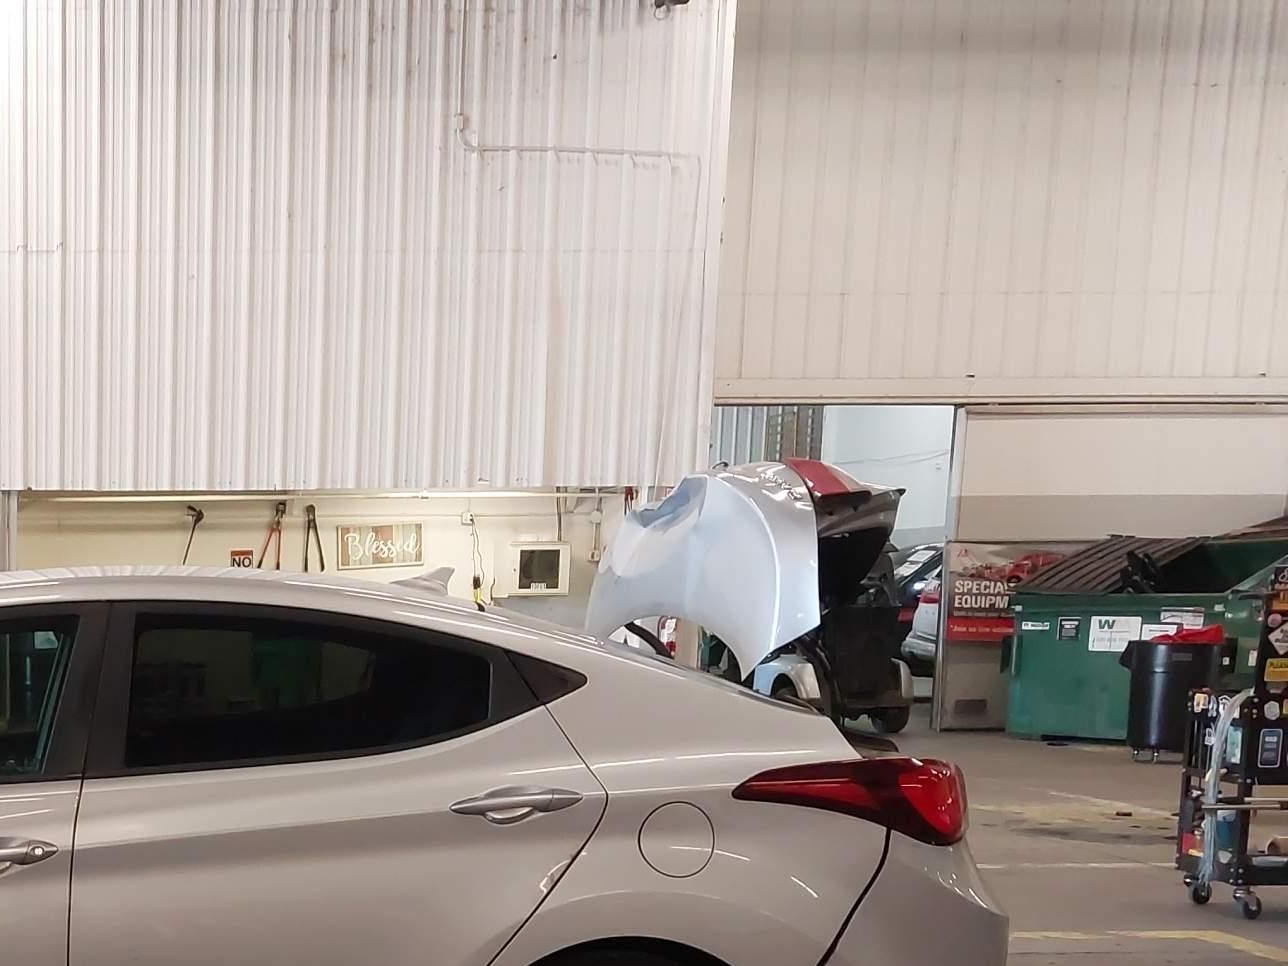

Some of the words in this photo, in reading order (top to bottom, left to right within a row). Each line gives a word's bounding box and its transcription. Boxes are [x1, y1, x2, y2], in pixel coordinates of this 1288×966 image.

[344, 531, 421, 561] Blessed
[232, 557, 252, 568] NO
[954, 595, 1009, 609] EQUIPM
